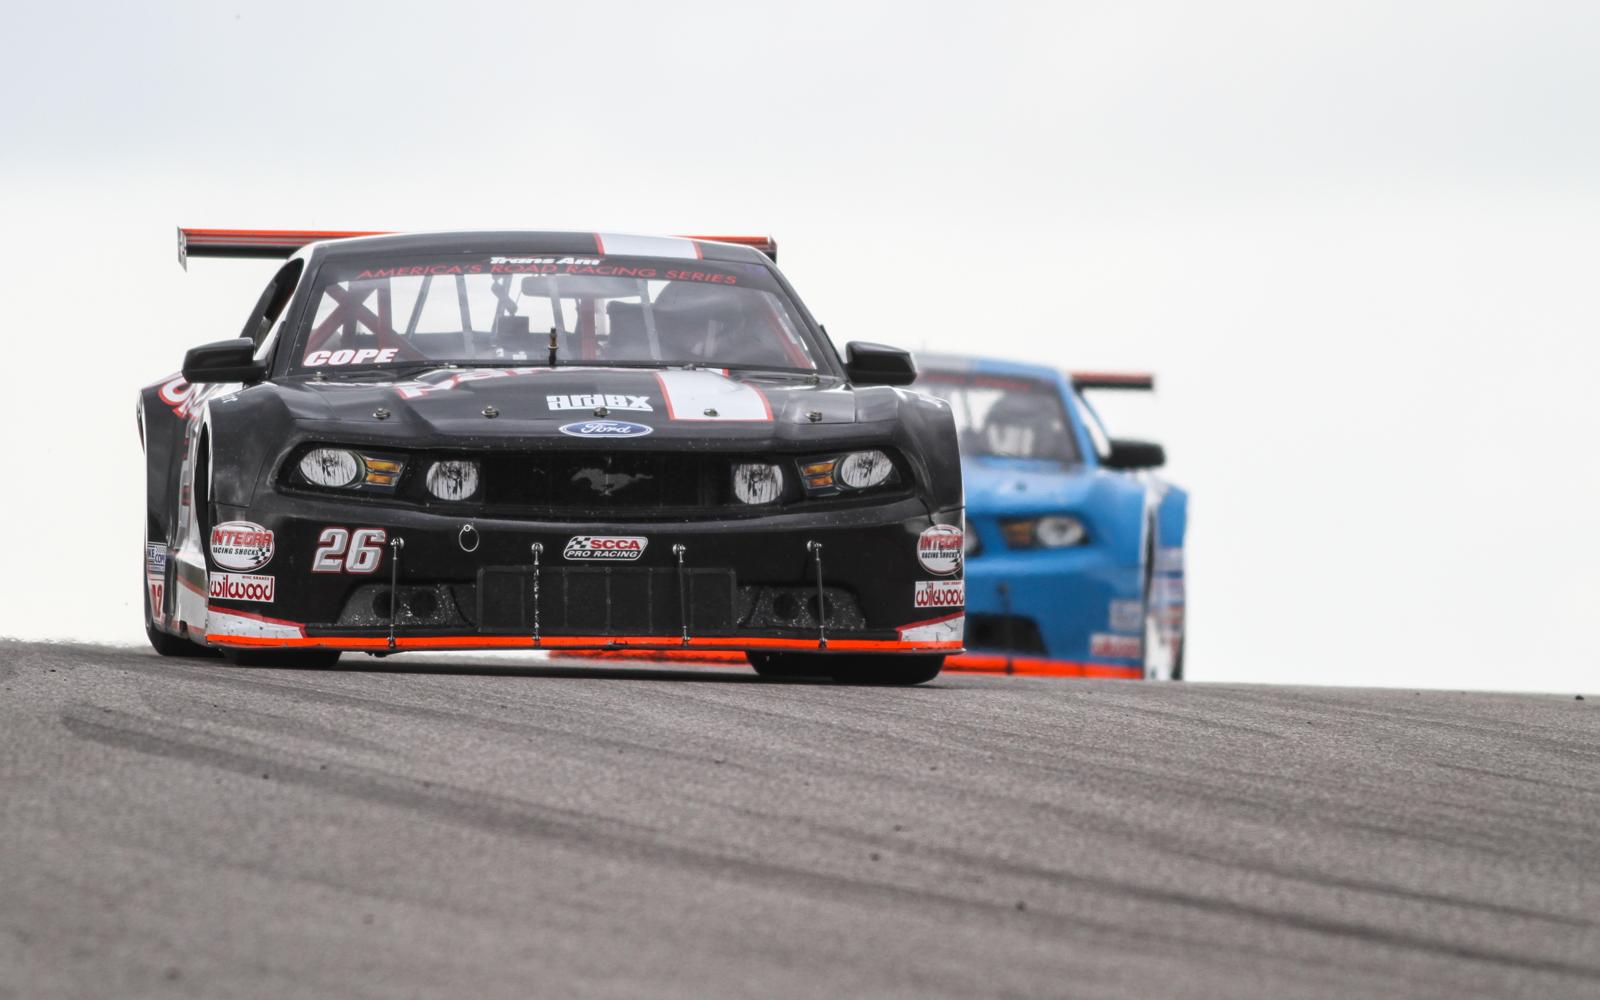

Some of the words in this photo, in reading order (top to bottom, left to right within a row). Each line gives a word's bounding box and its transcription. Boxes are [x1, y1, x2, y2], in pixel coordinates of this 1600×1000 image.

[490, 256, 556, 264] Trans
[556, 257, 600, 266] Am
[357, 264, 482, 280] AMERICA'S
[489, 264, 558, 273] ROAD
[565, 264, 657, 278] RACING
[665, 269, 737, 285] SERIES
[302, 348, 400, 367] COPE
[581, 423, 632, 434] Ford
[211, 529, 273, 547] INTEGRA
[311, 525, 387, 575] 26
[591, 539, 641, 550] SCCA
[234, 548, 259, 556] SHOCKS
[566, 550, 591, 558] PRO
[593, 550, 639, 558] RACING
[921, 551, 939, 559] RACING
[940, 551, 958, 559] SHOCKS
[210, 574, 274, 601] wilwood
